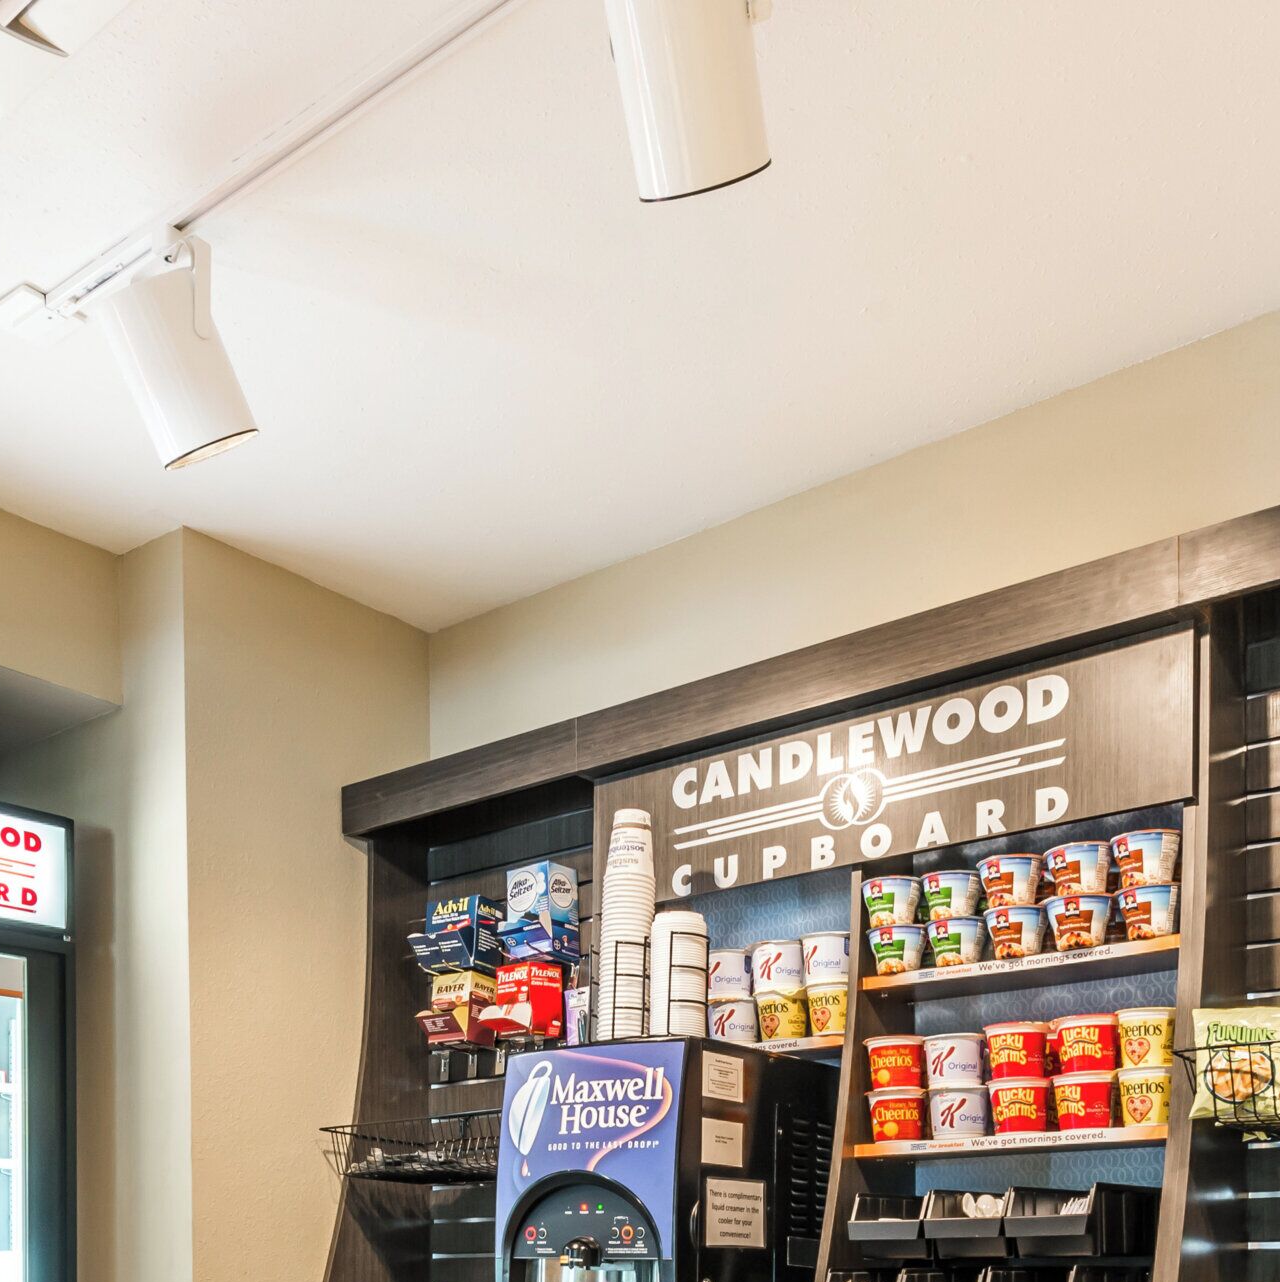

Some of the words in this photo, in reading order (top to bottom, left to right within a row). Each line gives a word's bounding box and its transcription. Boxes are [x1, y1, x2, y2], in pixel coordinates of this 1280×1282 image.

[672, 674, 1069, 810] CANDLEWOOD
[672, 787, 1069, 897] CUPBOARD
[509, 884, 535, 900] Seltzer
[551, 885, 571, 894] Seltzer
[434, 897, 469, 915] Advil
[479, 903, 496, 915] Advil
[813, 960, 841, 969] Original
[979, 961, 1005, 972] We've
[1010, 959, 1024, 970] got
[1027, 954, 1069, 968] mornings
[1072, 947, 1114, 961] covered.
[497, 967, 528, 983] TYLENOL
[531, 966, 560, 978] TYLENOL
[775, 967, 801, 977] Original
[714, 975, 741, 985] Original
[437, 983, 465, 994] BAYER
[474, 982, 495, 994] BAYER
[729, 1023, 754, 1032] Original
[871, 1055, 913, 1069] Cheerios
[948, 1062, 977, 1071] Original
[550, 1067, 664, 1104] Maxwell
[559, 1104, 649, 1134] House
[876, 1108, 918, 1121] Cheerios
[972, 1138, 997, 1147] We've
[1001, 1138, 1016, 1147] got
[1020, 1135, 1062, 1145] mornings
[1065, 1131, 1106, 1141] covered.
[548, 1142, 567, 1151] GOOD
[586, 1141, 599, 1149] THE
[603, 1140, 622, 1149] LAST
[710, 1189, 721, 1199] There
[728, 1191, 762, 1203] complimentary
[712, 1202, 724, 1212] liquid
[726, 1205, 745, 1213] creamer
[751, 1206, 759, 1214] the
[718, 1217, 733, 1225] cooler
[742, 1219, 752, 1227] your
[720, 1230, 751, 1239] convenience!
